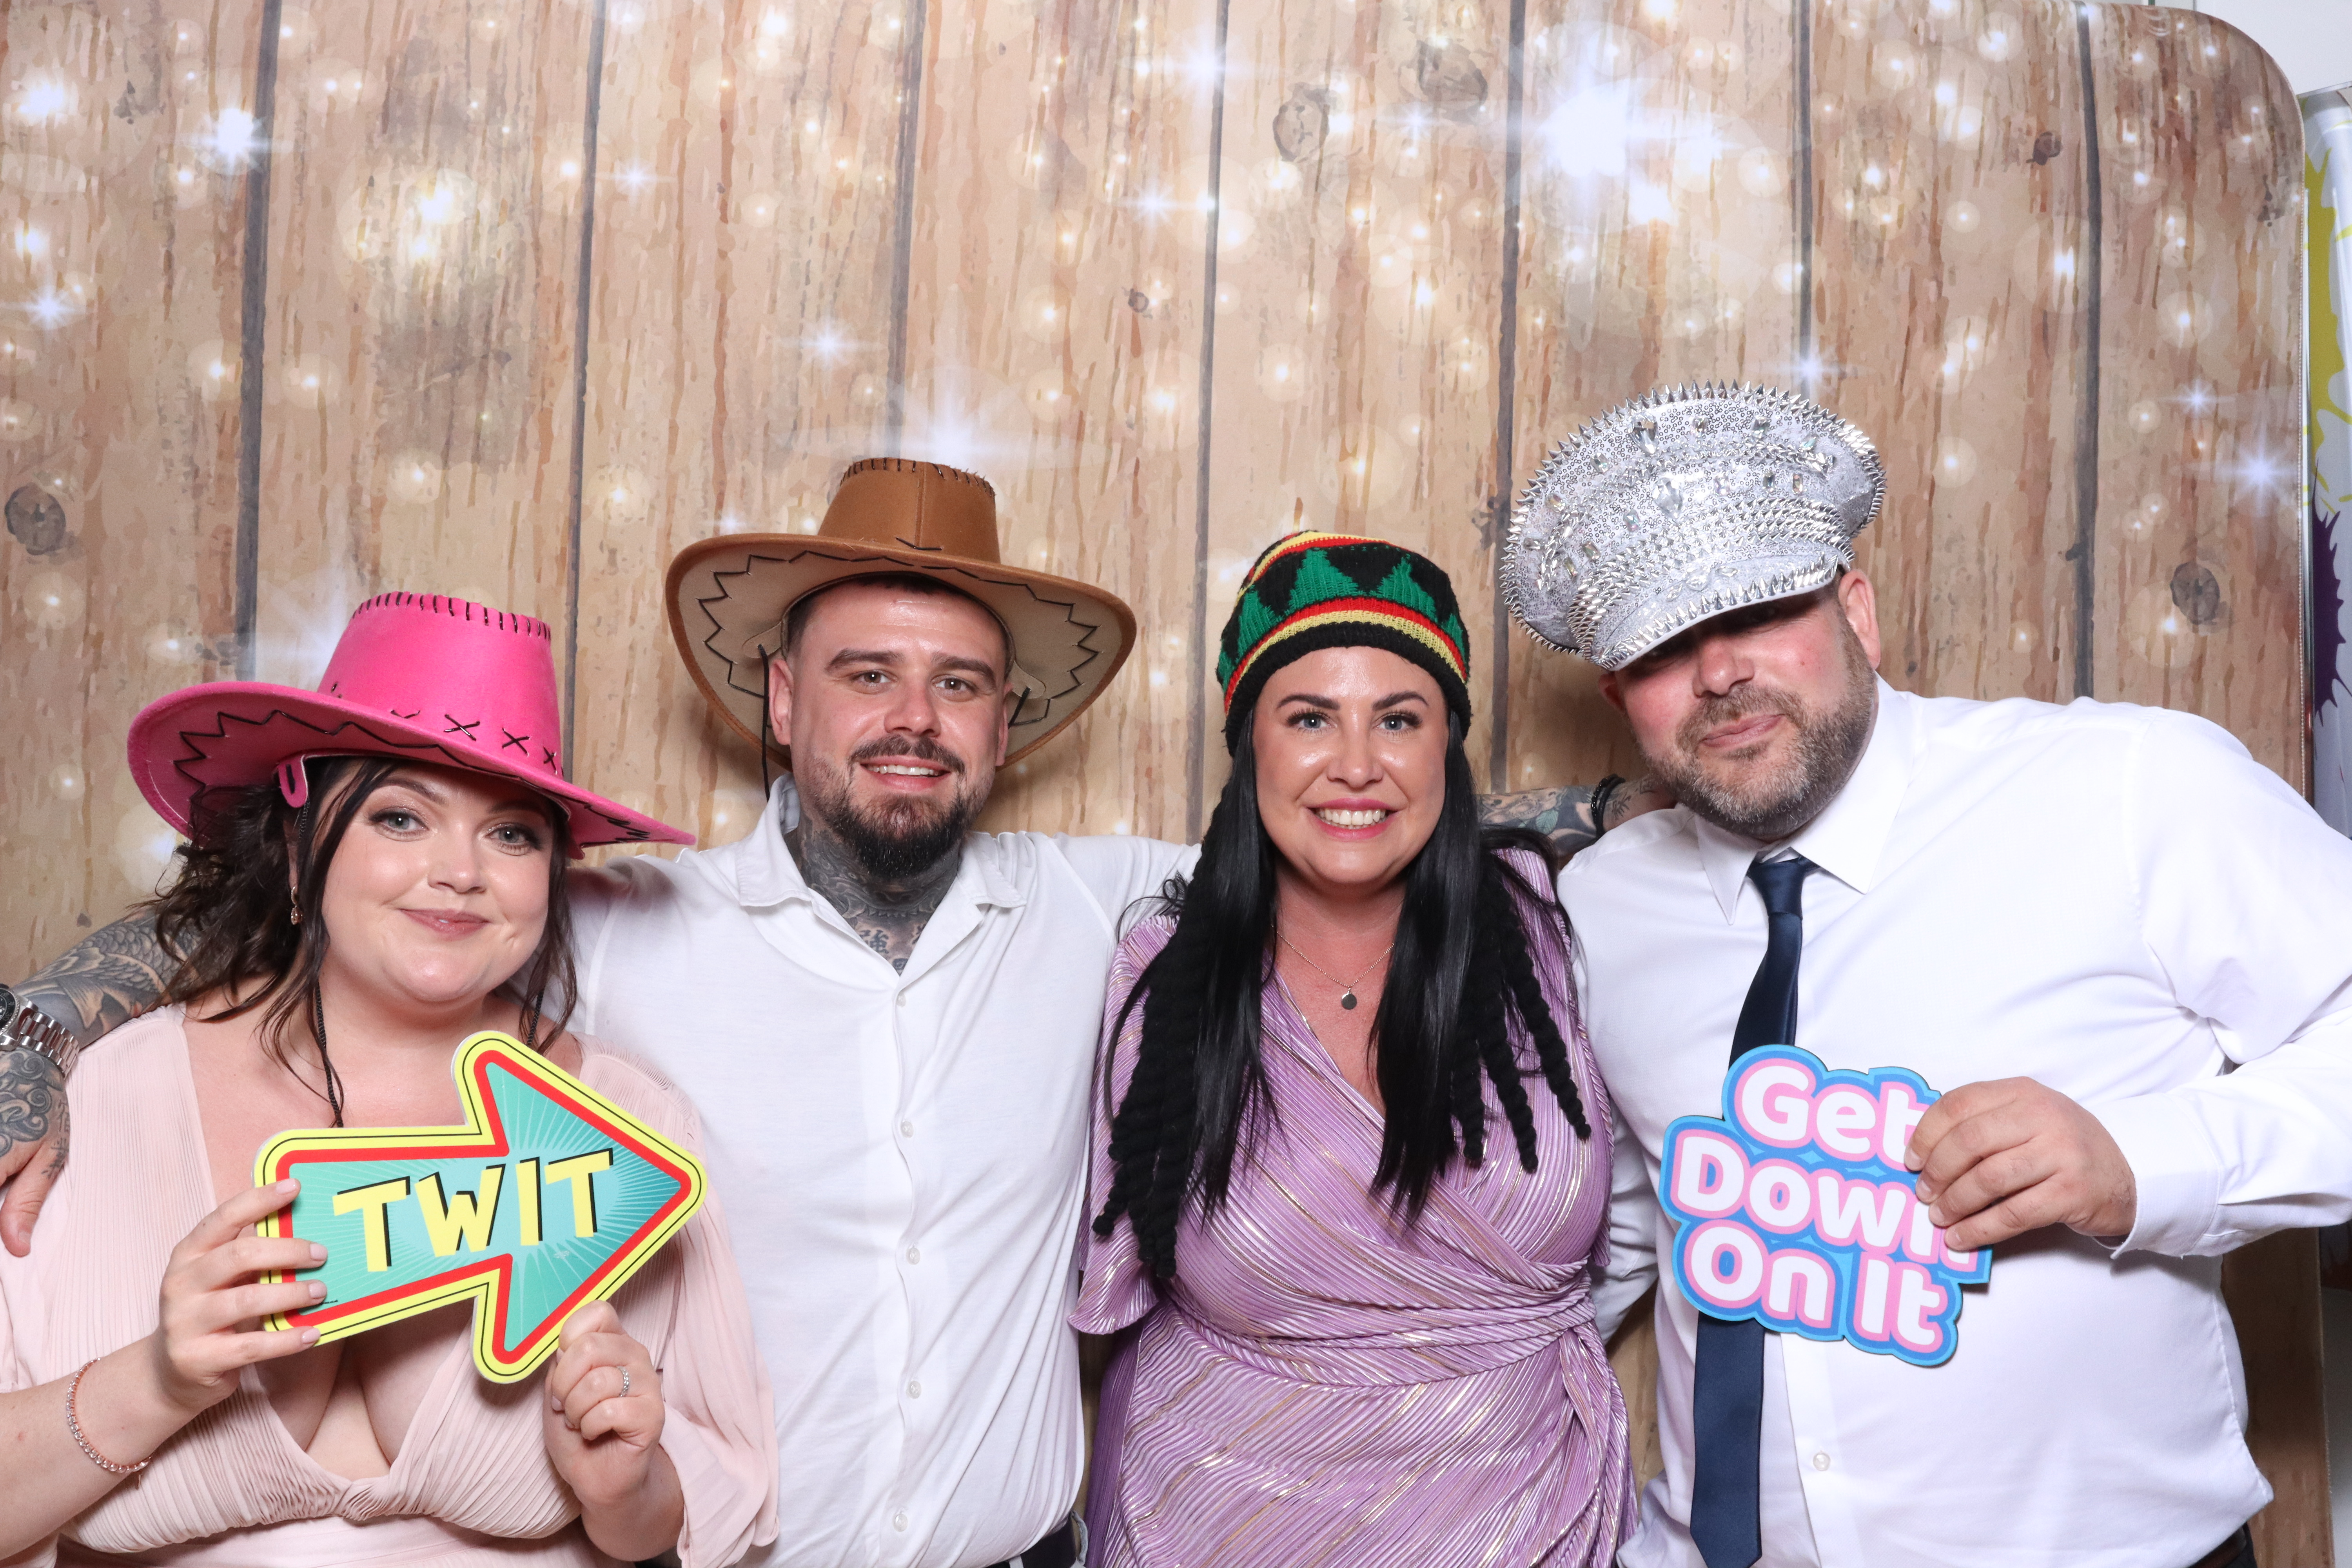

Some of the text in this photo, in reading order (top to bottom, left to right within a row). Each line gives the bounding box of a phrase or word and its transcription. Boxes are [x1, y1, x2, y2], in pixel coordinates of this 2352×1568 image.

[1738, 1062, 1926, 1165] Get
[333, 1148, 613, 1272] TWIT
[1688, 1224, 1943, 1348] On It
